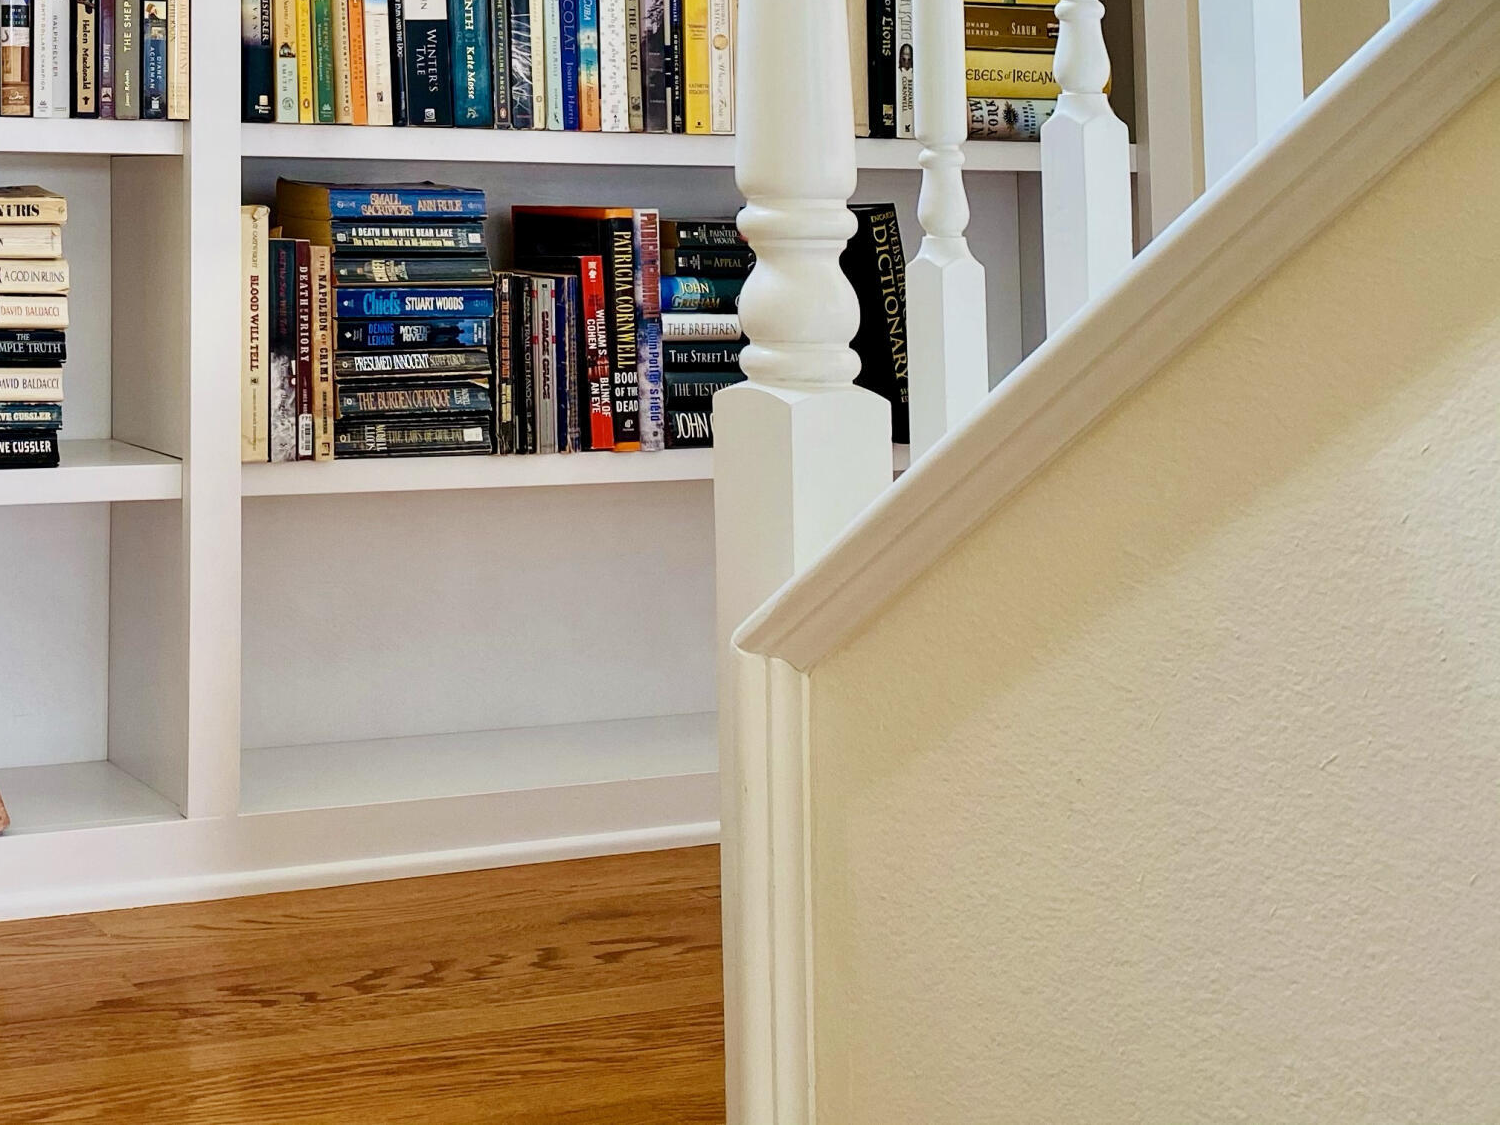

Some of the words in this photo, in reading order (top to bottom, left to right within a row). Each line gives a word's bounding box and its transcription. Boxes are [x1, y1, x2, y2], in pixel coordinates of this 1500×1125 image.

[1011, 22, 1037, 36] SARUM
[416, 46, 425, 75] TALE
[426, 29, 438, 92] WINTER'S
[614, 230, 632, 290] PATRICIA
[364, 292, 400, 315] Chiefs
[405, 297, 435, 311] STUART
[436, 297, 464, 310] WOODS
[873, 227, 908, 379] DICTIONARY
[616, 296, 637, 368] CORNWELL
[667, 323, 685, 335] THE
[688, 323, 737, 335] BRETHREN
[614, 373, 637, 383] BOOK
[615, 387, 625, 397] OF
[616, 400, 638, 412] DEAD
[13, 441, 51, 453] CUSSLER
